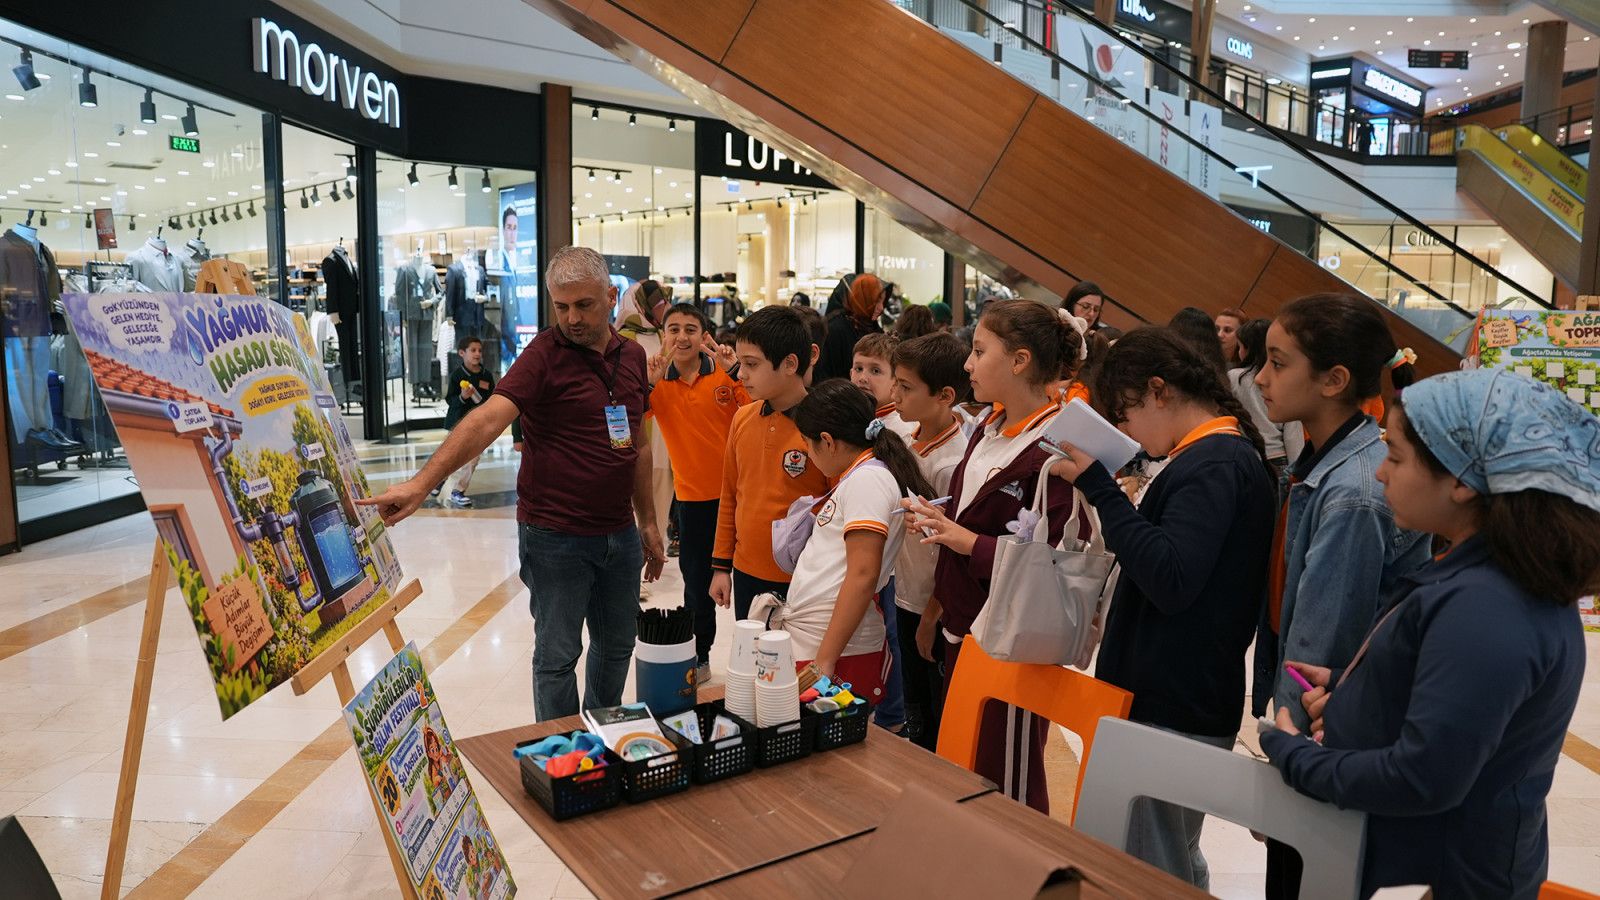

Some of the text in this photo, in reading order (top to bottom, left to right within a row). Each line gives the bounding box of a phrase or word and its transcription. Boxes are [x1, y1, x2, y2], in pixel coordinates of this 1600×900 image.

[252, 17, 400, 128] morven
[173, 137, 197, 146] EXIT
[111, 314, 134, 325] GELEN
[186, 297, 272, 353] YAĞMUR
[209, 340, 272, 394] HASADI
[220, 586, 242, 611] Küçük
[225, 598, 251, 628] Adımlar
[234, 613, 255, 638] Büyük
[363, 667, 416, 742] SÜRDÜRÜLEBİLİR
[389, 688, 421, 729] FESTİVALİ
[398, 771, 407, 788] Su
[403, 752, 418, 774] Dostu
[384, 775, 398, 813] 20
